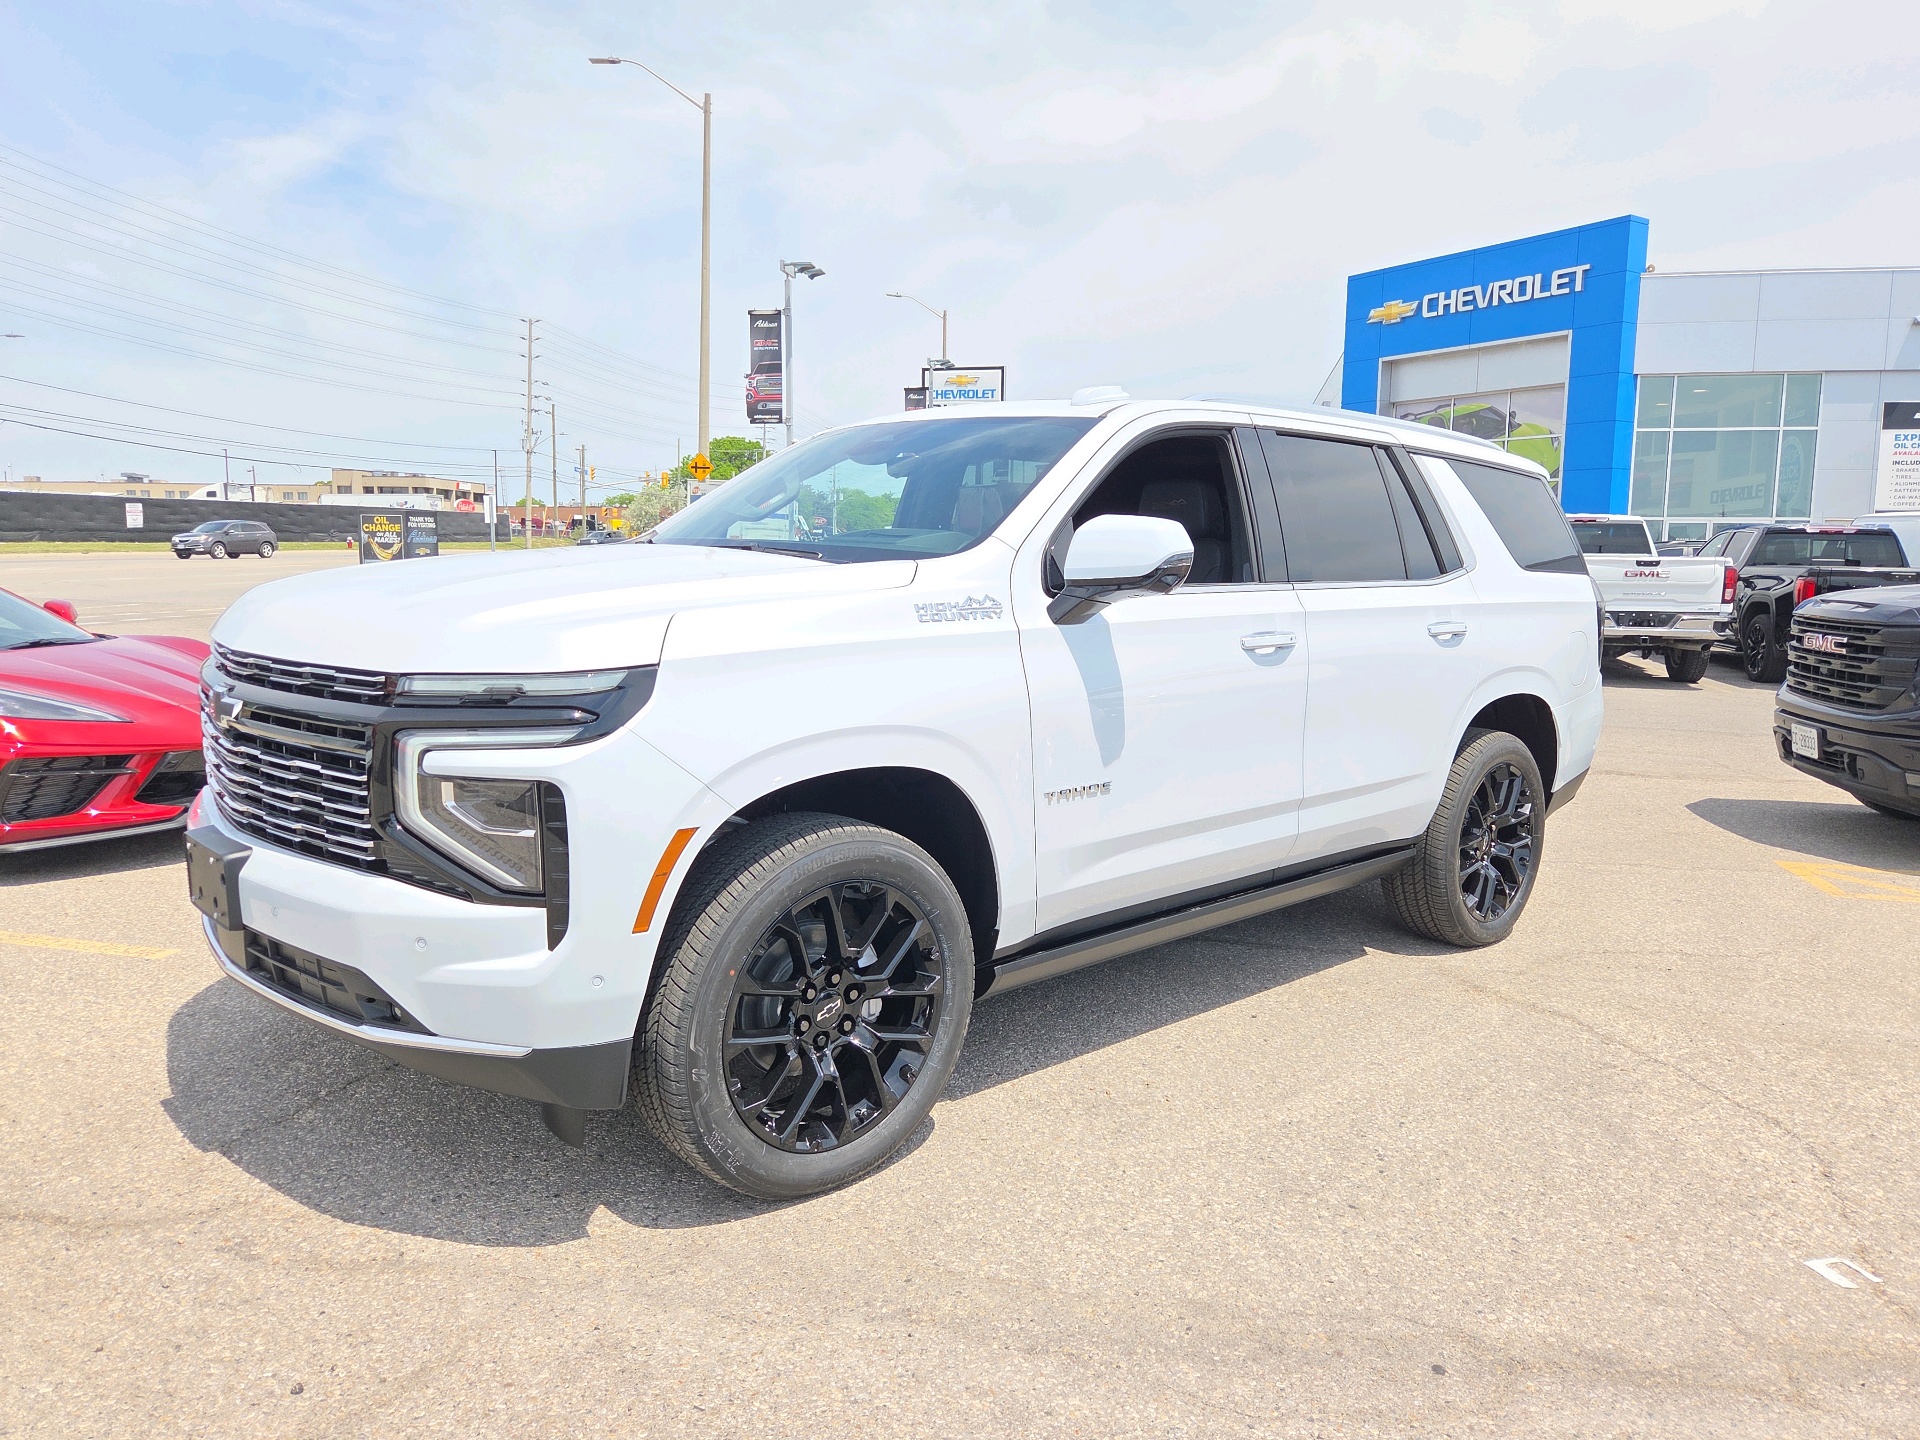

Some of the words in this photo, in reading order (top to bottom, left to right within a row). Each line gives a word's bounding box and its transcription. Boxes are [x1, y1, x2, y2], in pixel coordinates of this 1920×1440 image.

[1421, 263, 1591, 319] CHEVROLET
[373, 516, 390, 524] OIL
[362, 524, 402, 532] CHANGE
[1624, 569, 1671, 579] GMC
[914, 601, 961, 614] HIGH
[917, 609, 1004, 623] COUNTRY
[1803, 632, 1848, 655] GMC
[1043, 780, 1113, 807] TAHOE
[789, 845, 876, 882] BRIDGESTONE
